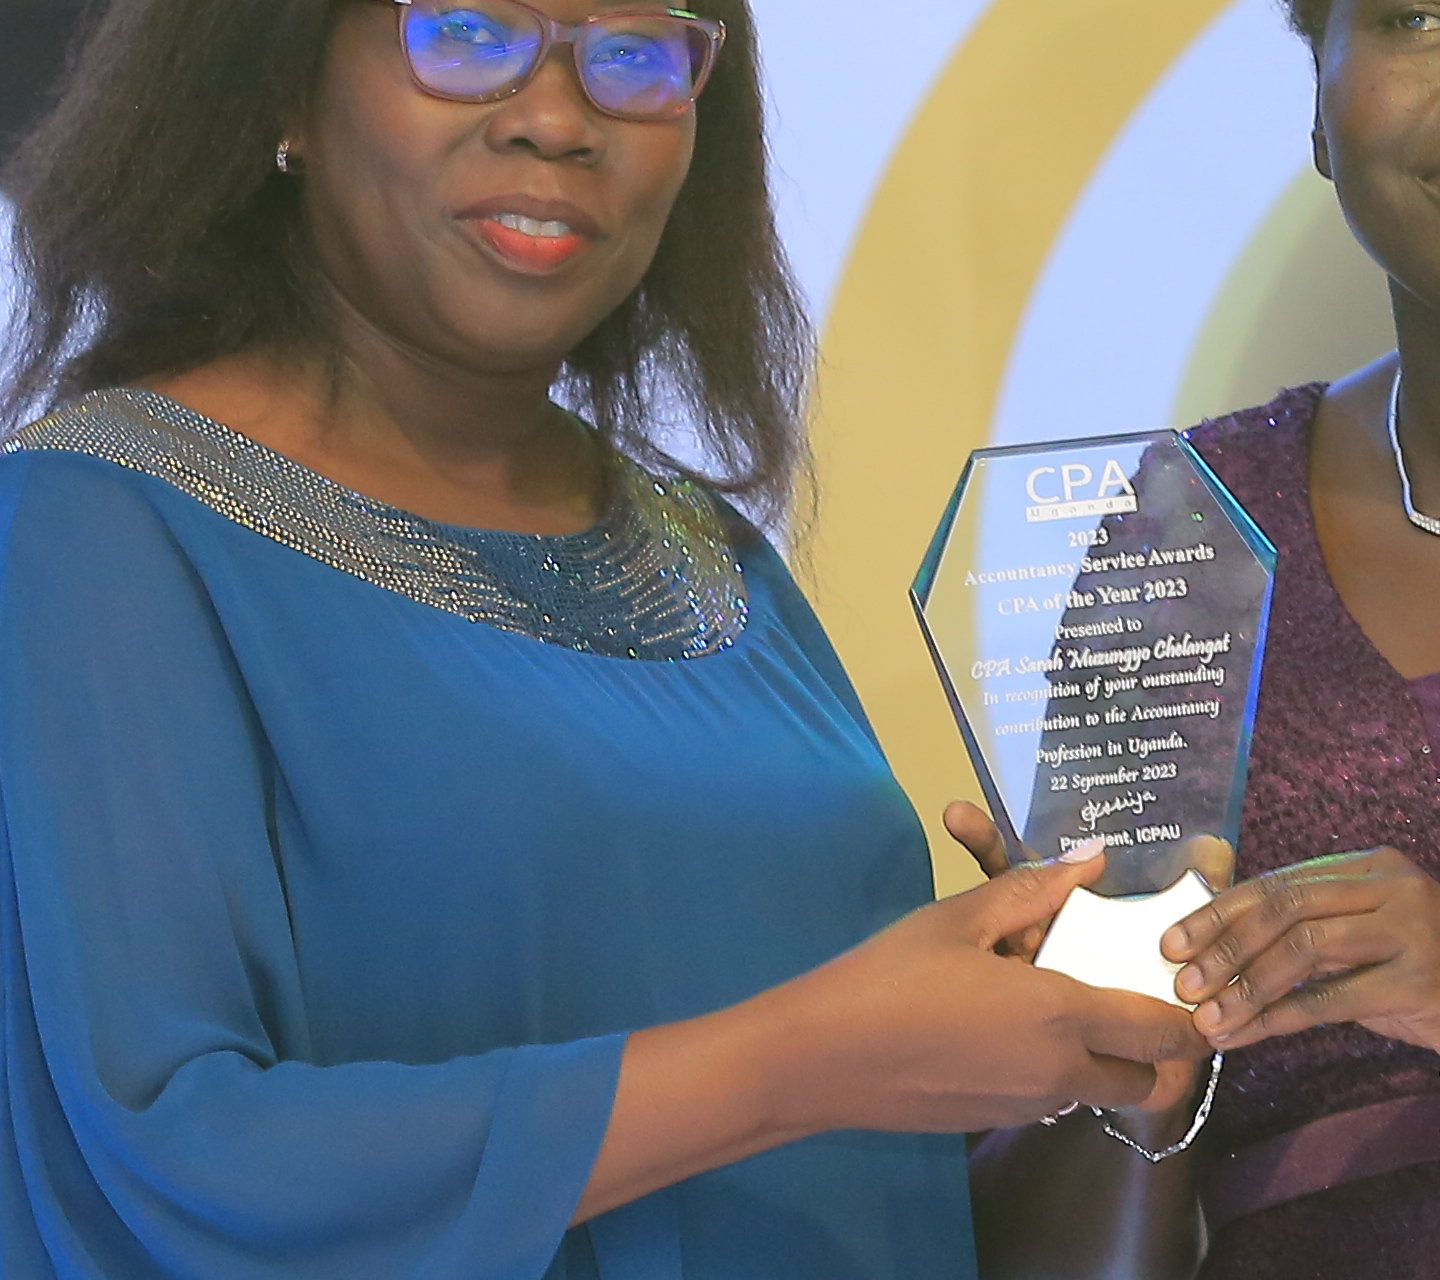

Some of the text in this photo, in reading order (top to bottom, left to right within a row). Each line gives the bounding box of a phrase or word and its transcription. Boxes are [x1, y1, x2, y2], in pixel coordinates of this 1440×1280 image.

[1025, 459, 1136, 505] CPA
[1067, 527, 1109, 547] 2023
[963, 542, 1215, 586] Accountancy Service Awards
[997, 579, 1188, 616] CPA of the Year 2023
[1055, 616, 1142, 640] Presented to
[971, 659, 1012, 680] CPA
[1015, 647, 1063, 676] Sarah
[983, 664, 1225, 705] In recognition of your outstanding
[994, 697, 1221, 736] contribution to the Accountancy
[1035, 730, 1189, 768] Profession in Uganda.
[1049, 762, 1178, 795] 22 September 2023
[1136, 823, 1182, 844] ICPAU
